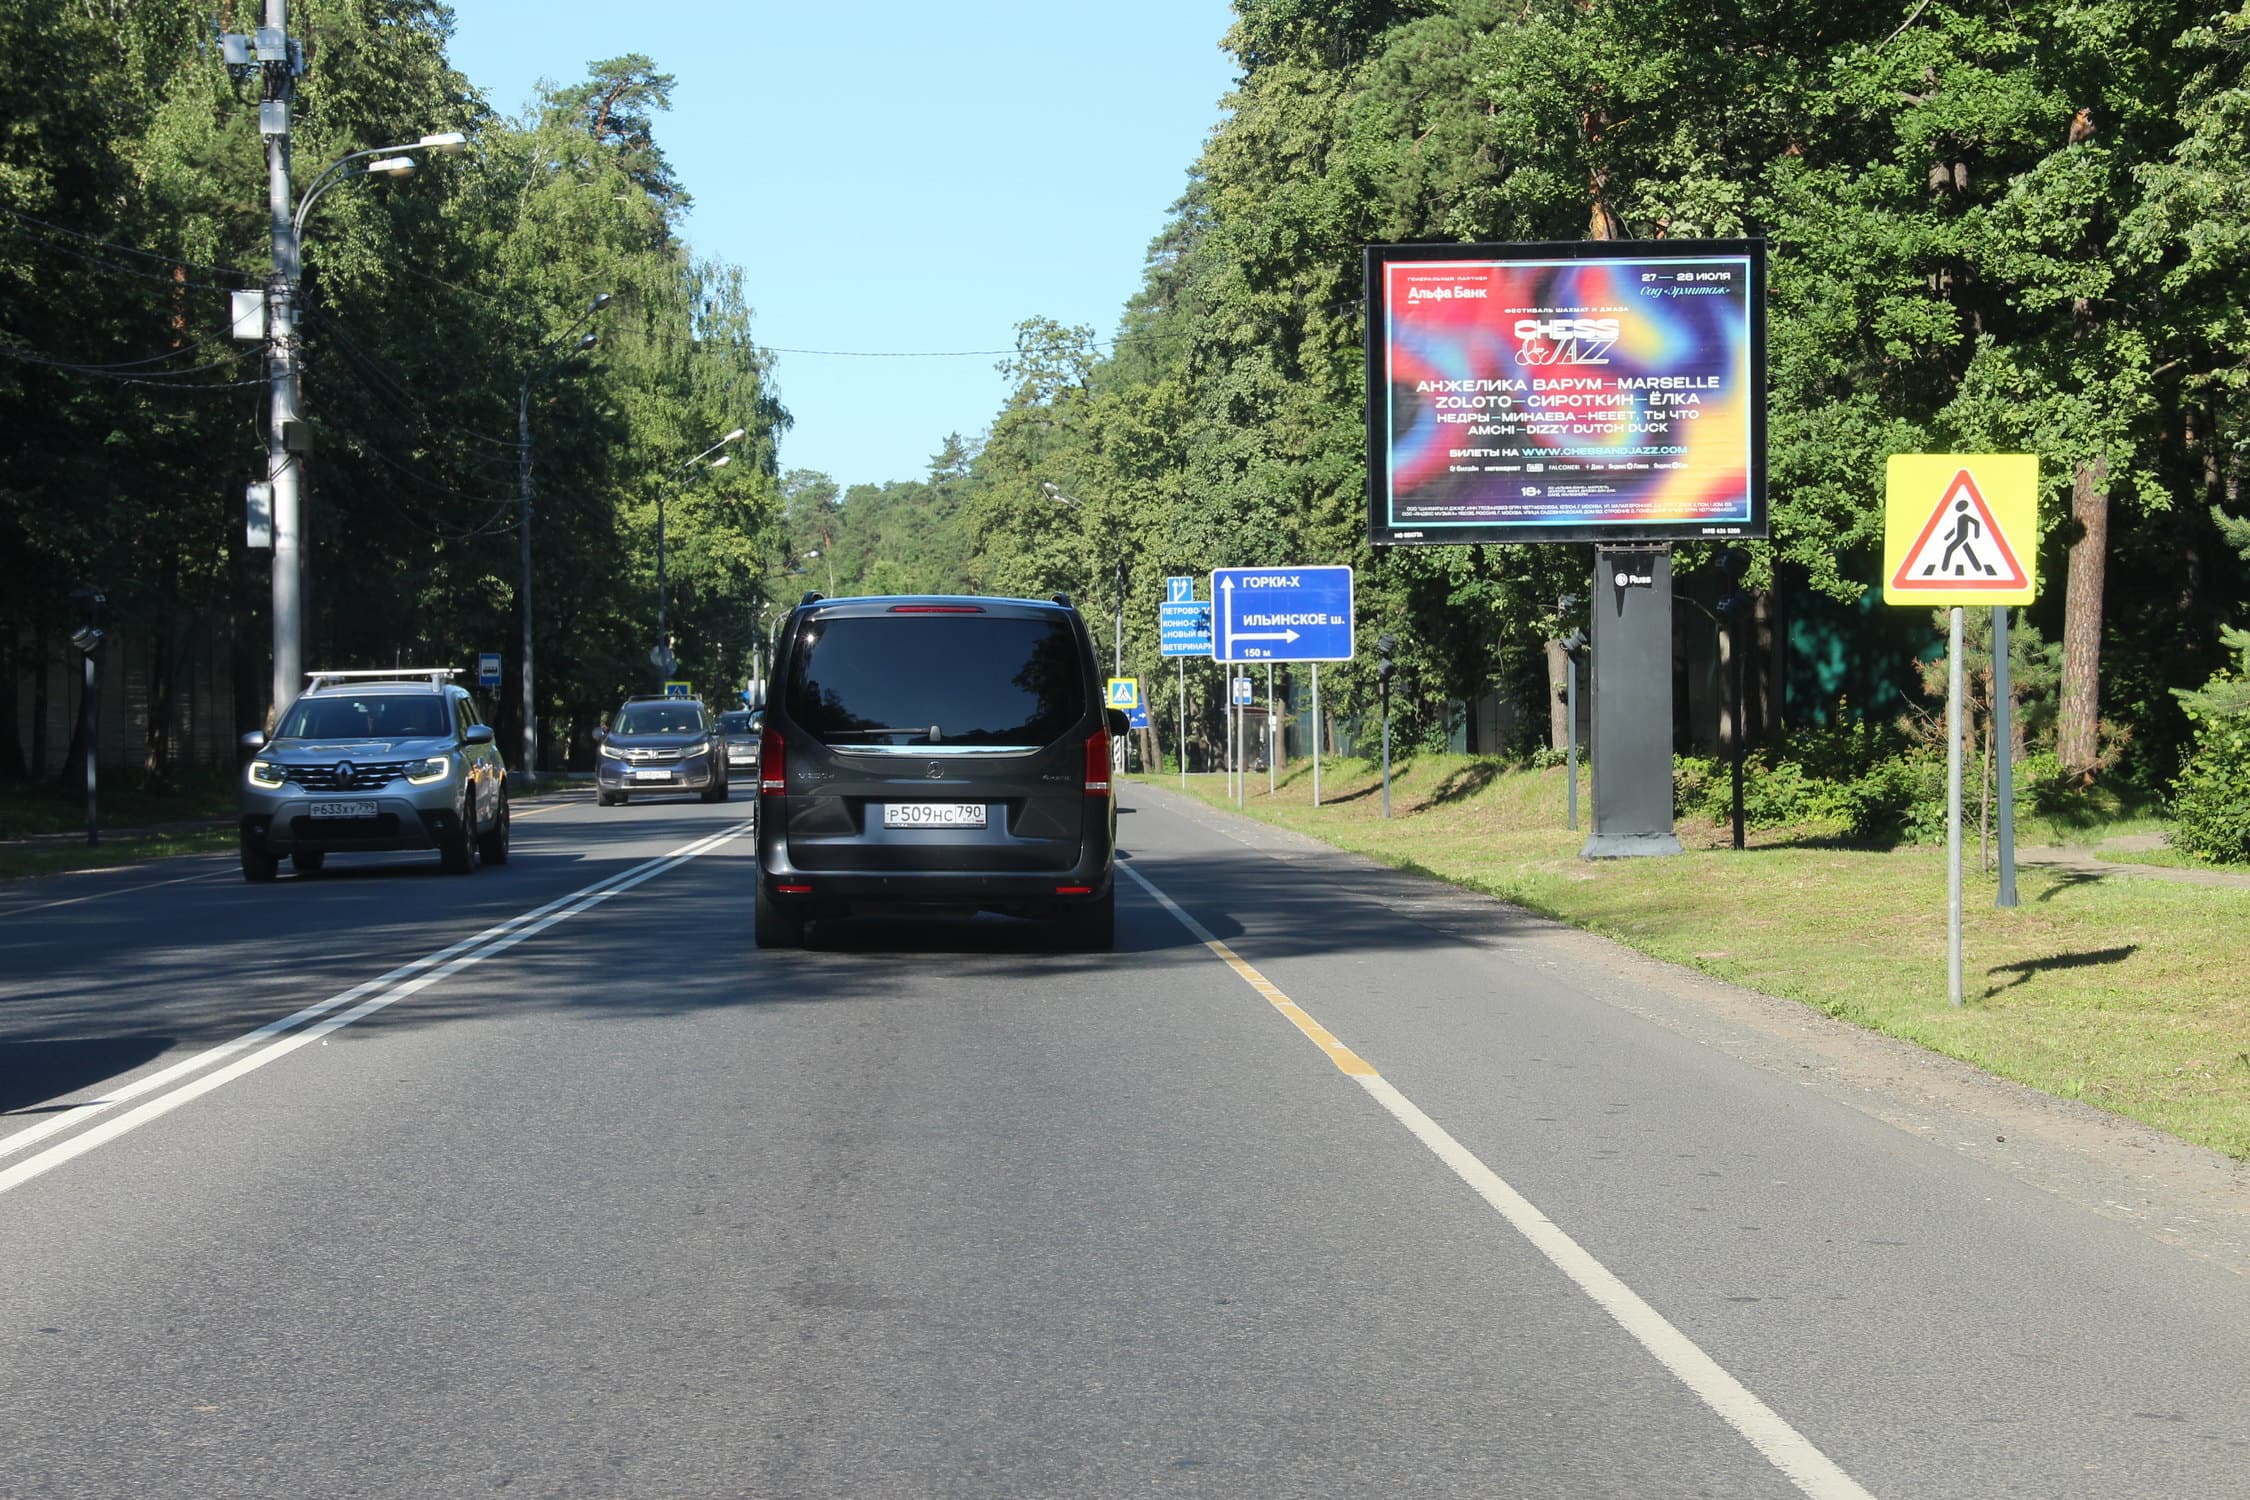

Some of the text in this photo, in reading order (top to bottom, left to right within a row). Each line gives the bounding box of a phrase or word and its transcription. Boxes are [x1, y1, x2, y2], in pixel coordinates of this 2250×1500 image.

[1696, 272, 1731, 281] ИЮЛЯ
[1408, 286, 1488, 301] Альфа Банк
[1640, 286, 1662, 298] Сад
[1514, 318, 1620, 340] CHESS
[1416, 379, 1528, 392] АНЖЕЛИКА
[1645, 410, 1666, 420] ТЫ
[1669, 409, 1700, 420] ЧТО
[1573, 423, 1625, 434] DUTCH
[1628, 422, 1669, 433] DUCK
[1449, 445, 1689, 458] БИЛЕТЫ НА WWW.CHESSANDJAZZ.COM
[1520, 486, 1542, 497] 18+
[1629, 574, 1652, 584] Russ
[1243, 613, 1346, 626] ИЛЬИНСКОЕ ш.
[1244, 649, 1261, 657] 150
[956, 805, 982, 818] 790
